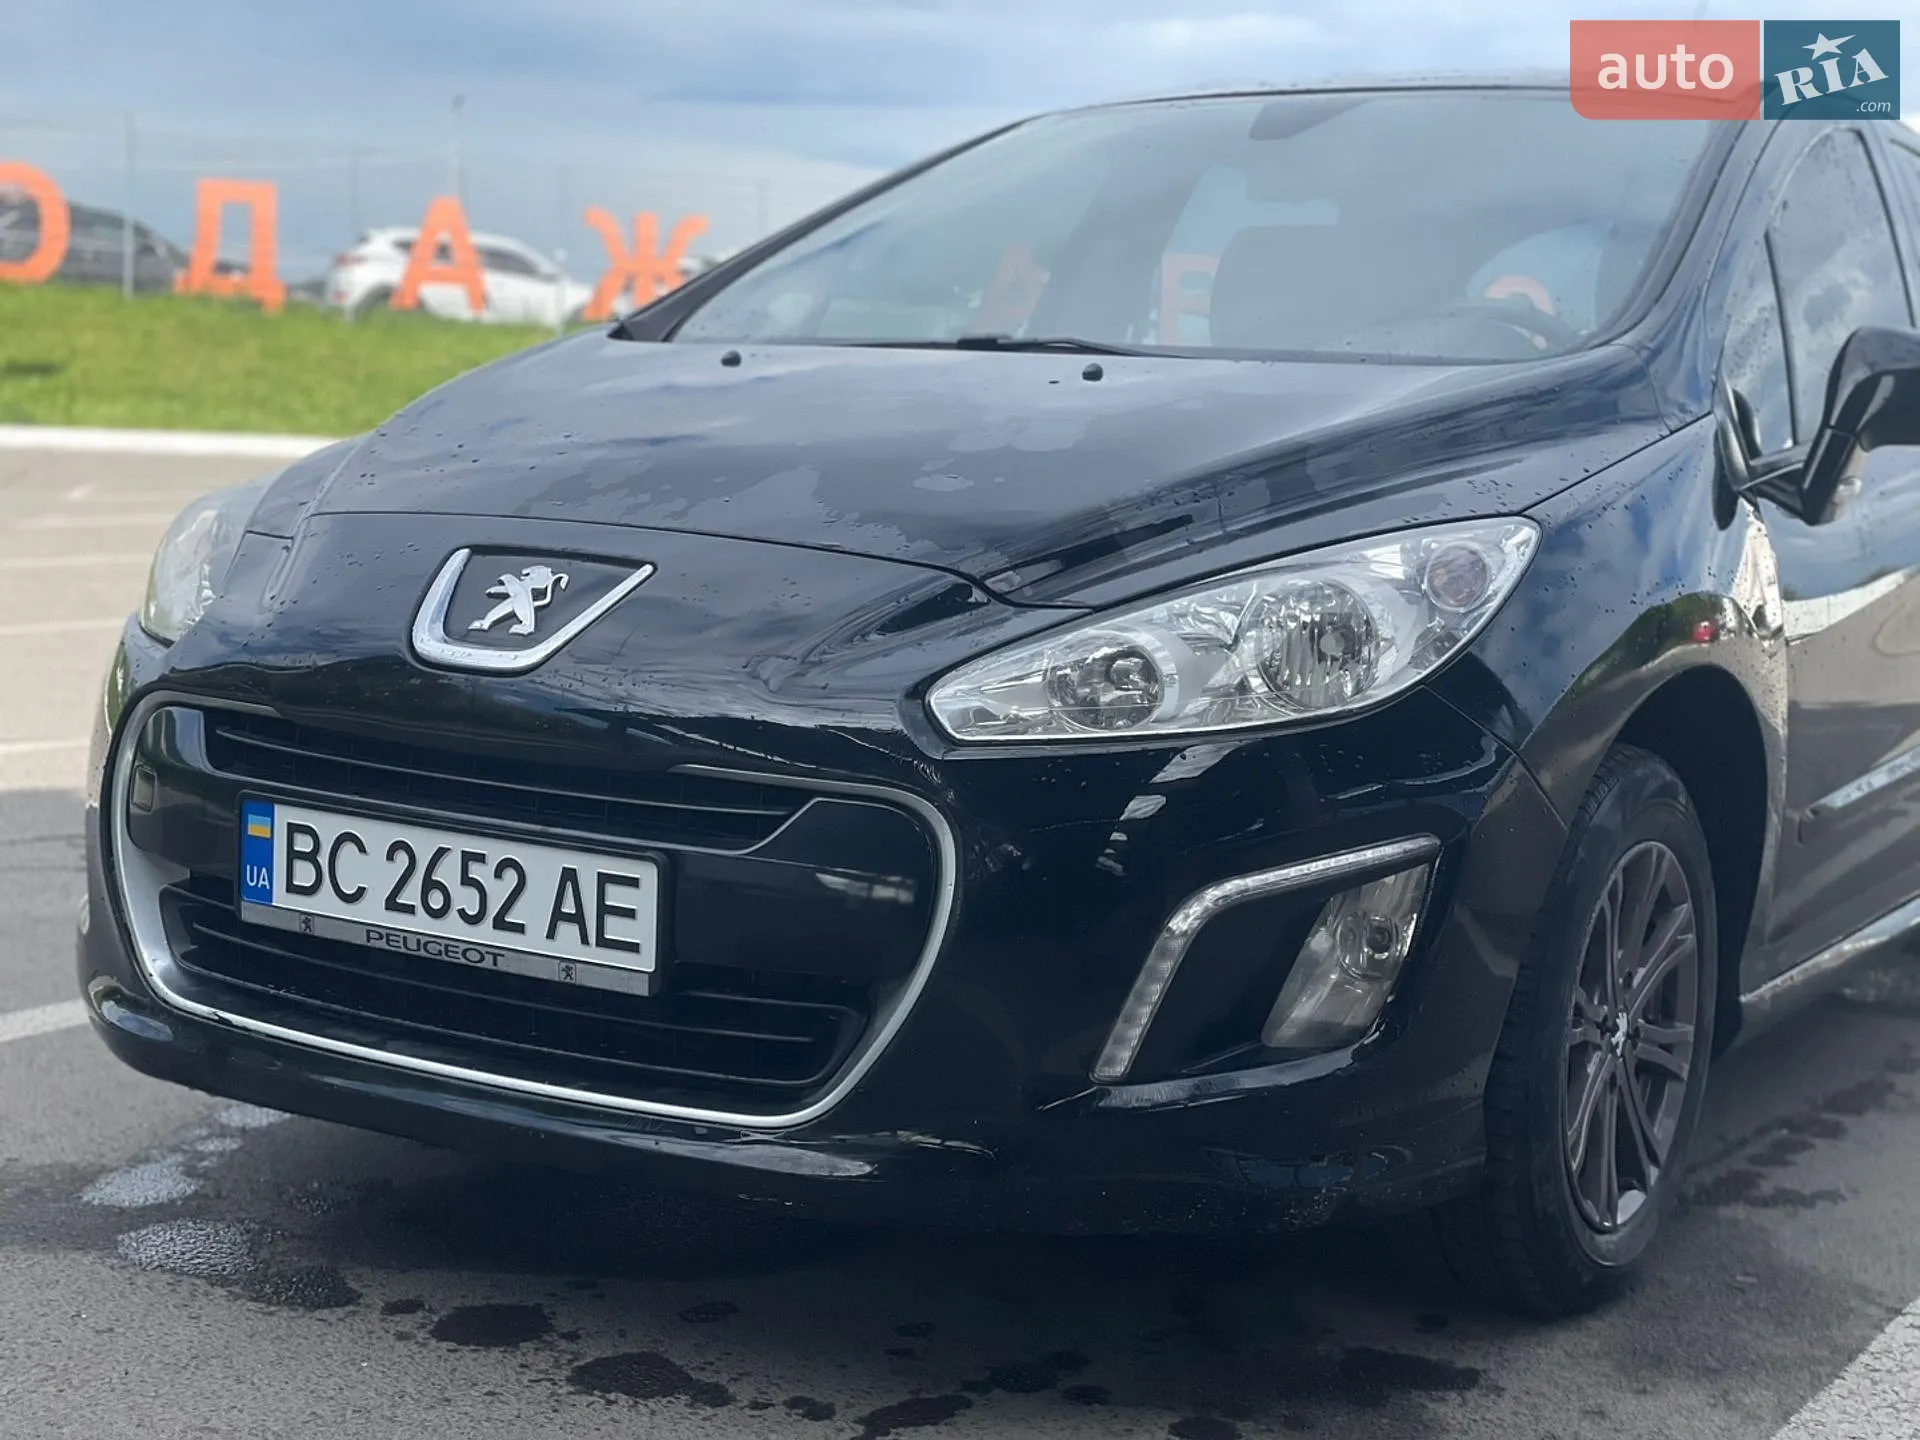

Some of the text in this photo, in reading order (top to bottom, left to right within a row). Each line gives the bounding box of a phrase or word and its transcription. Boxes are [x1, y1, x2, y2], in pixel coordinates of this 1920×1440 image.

[246, 864, 271, 890] UA
[285, 821, 641, 954] BC 2652 AE
[365, 929, 505, 968] PEUGEOT
